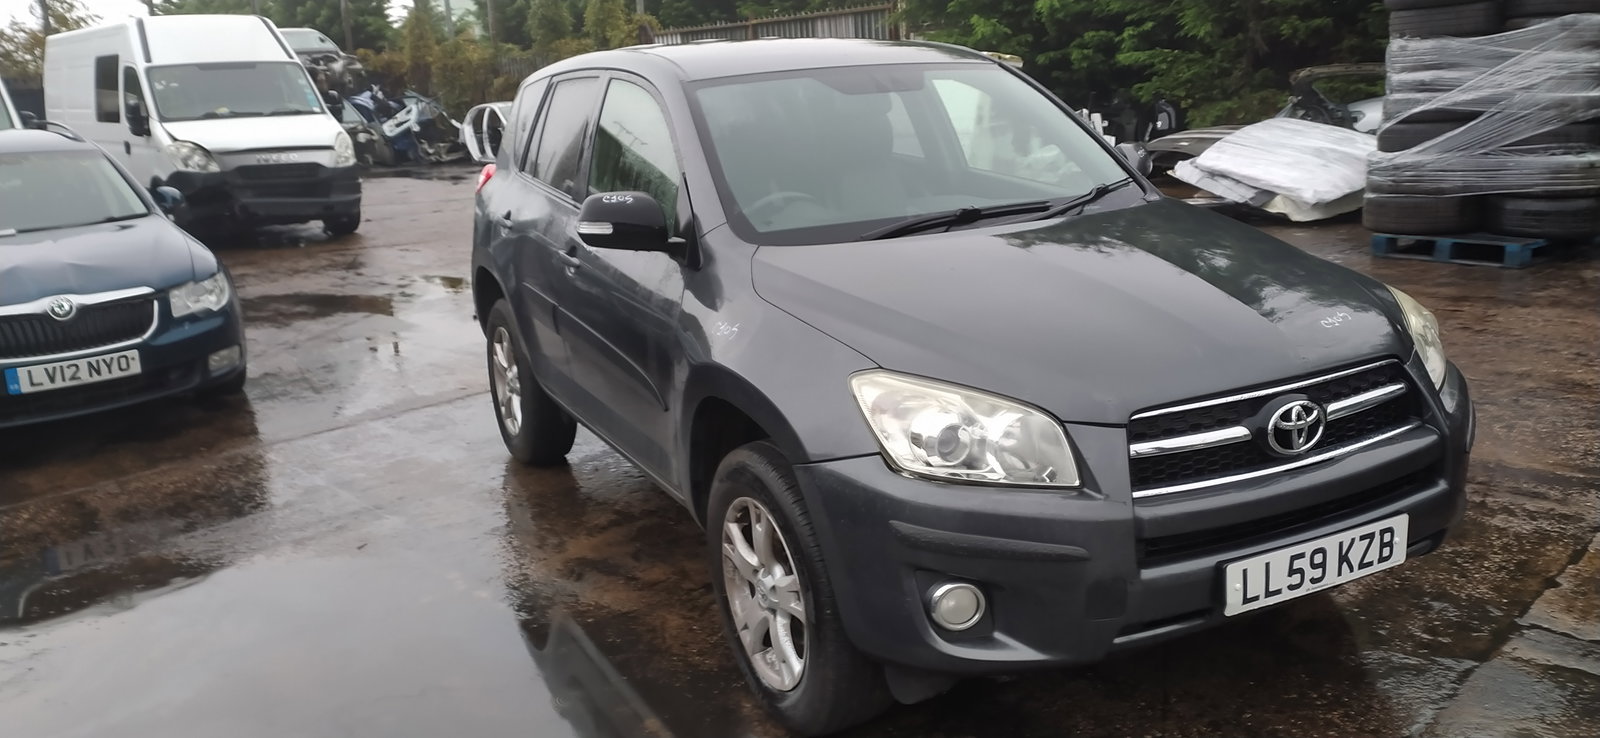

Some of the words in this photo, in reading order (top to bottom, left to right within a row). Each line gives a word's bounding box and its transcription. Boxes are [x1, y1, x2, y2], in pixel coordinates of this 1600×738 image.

[27, 364, 82, 387] LV12
[87, 355, 130, 378] NYO
[1241, 547, 1328, 605] LL59
[1337, 526, 1395, 577] KZB
